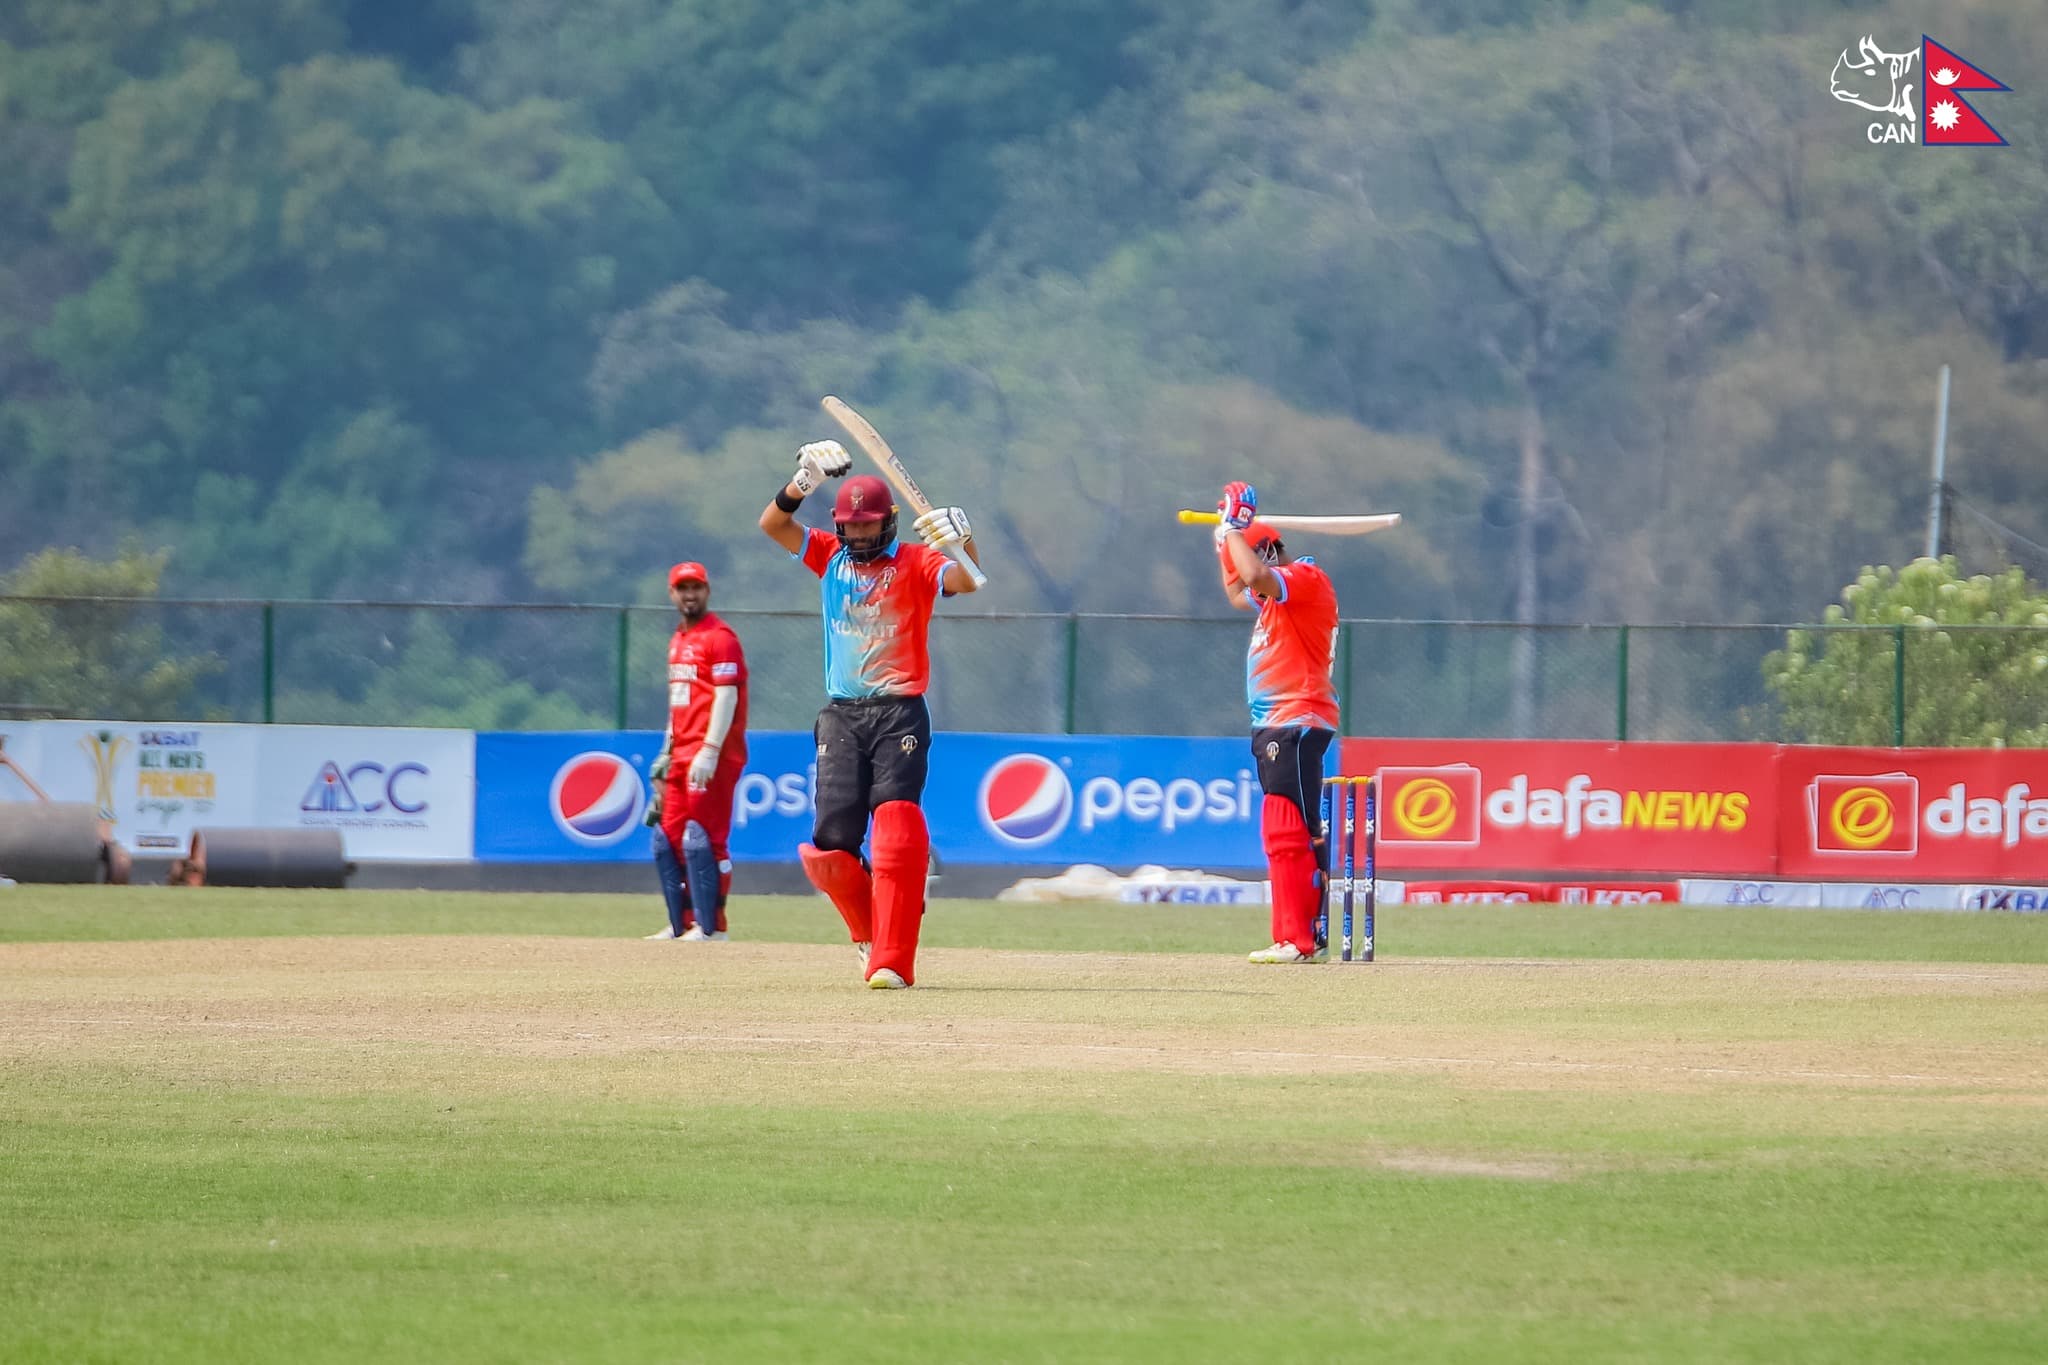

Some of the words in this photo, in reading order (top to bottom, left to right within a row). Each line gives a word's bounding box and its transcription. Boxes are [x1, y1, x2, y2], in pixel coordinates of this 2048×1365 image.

[301, 761, 428, 813] ACC
[1080, 769, 1252, 832] pepsi
[1138, 886, 1244, 904] 1XBAT
[1727, 883, 1776, 904] ACC
